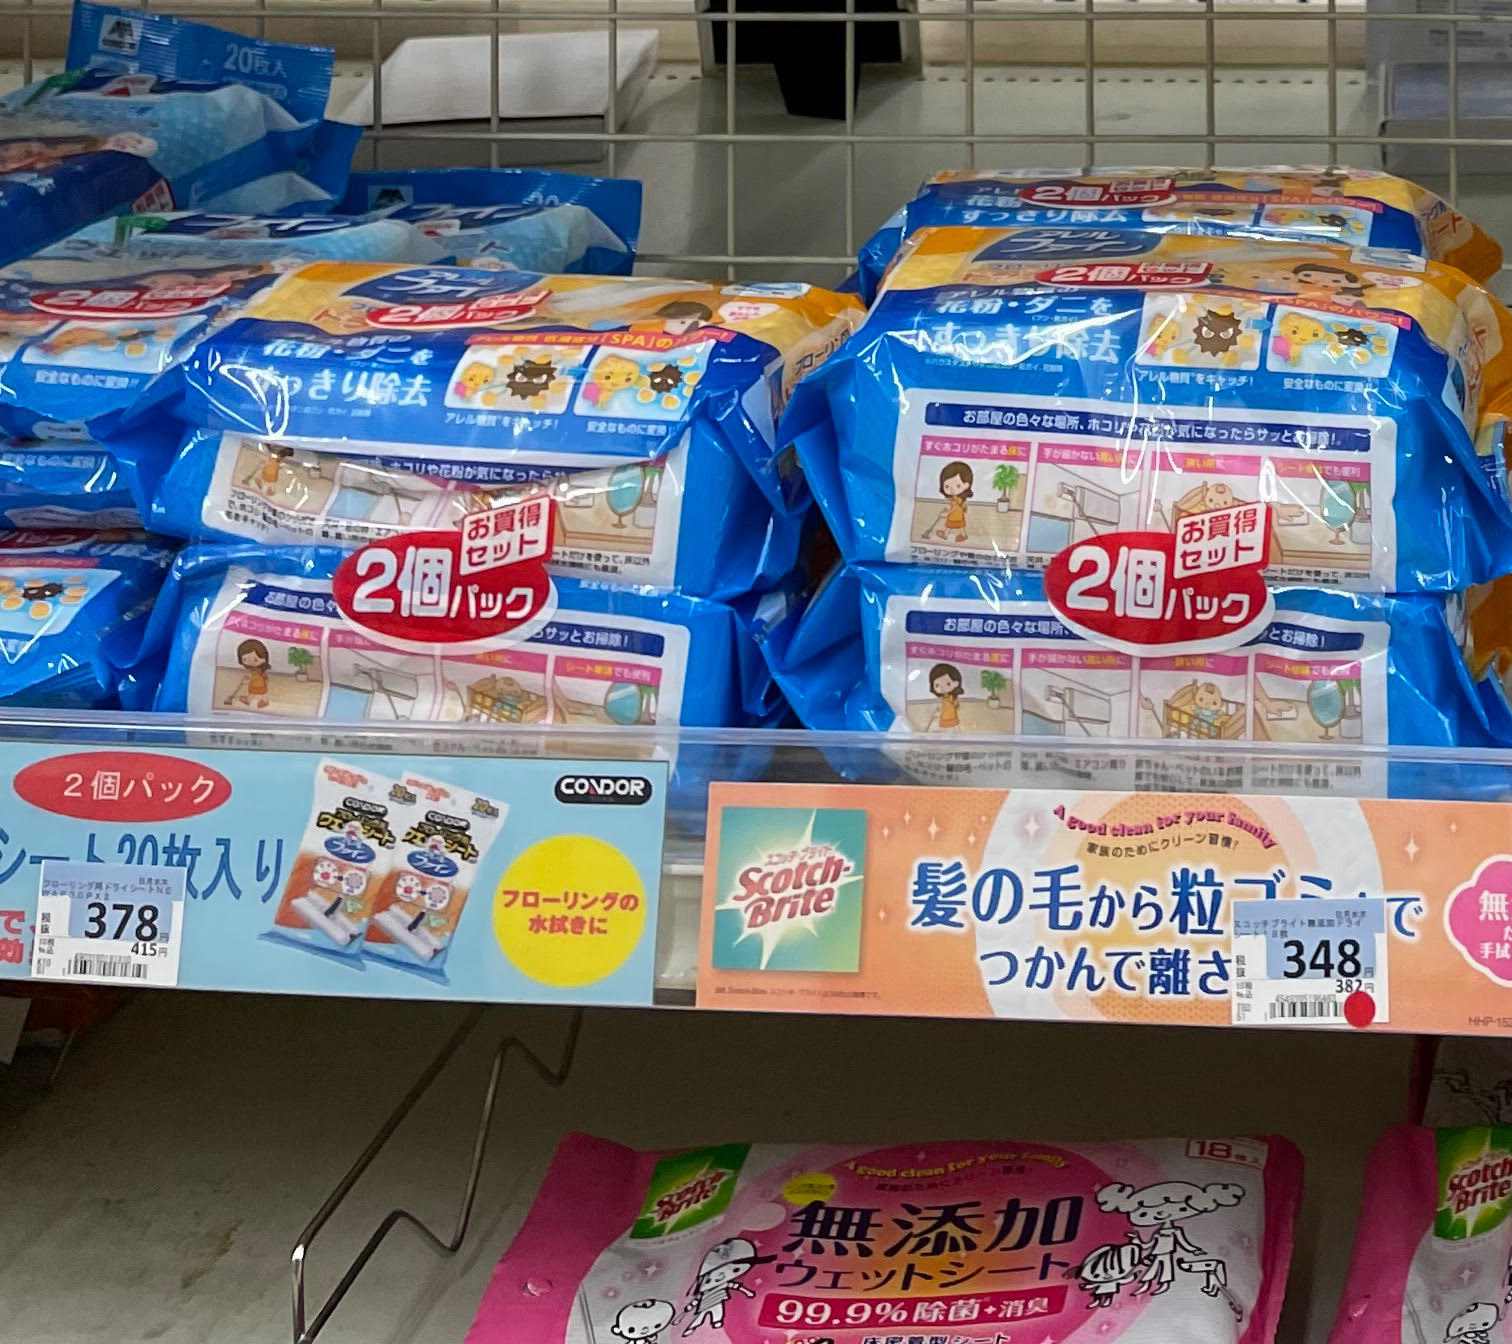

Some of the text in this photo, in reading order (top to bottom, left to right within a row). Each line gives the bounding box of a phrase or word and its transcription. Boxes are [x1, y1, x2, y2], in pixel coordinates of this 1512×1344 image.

[224, 43, 288, 77] 20枚入
[466, 513, 543, 544] お買得
[1182, 506, 1260, 543] お買得
[465, 537, 538, 567] セット
[1180, 540, 1256, 569] セット
[352, 544, 534, 621] 2個パック
[1065, 543, 1250, 623] 2個パック
[63, 770, 215, 804] 2個パック
[559, 778, 645, 797] CONDOR
[1063, 816, 1107, 839] good
[1111, 819, 1154, 838] clean
[1156, 812, 1182, 835] for
[1183, 810, 1224, 833] your
[1225, 812, 1275, 850] family
[732, 853, 851, 902] Scotch-
[501, 889, 640, 912] フローリングの
[745, 888, 834, 930] Brite
[528, 915, 608, 936] 水拭きに
[782, 1195, 1084, 1258] 無添加
[773, 1253, 1070, 1291] ウェットシート
